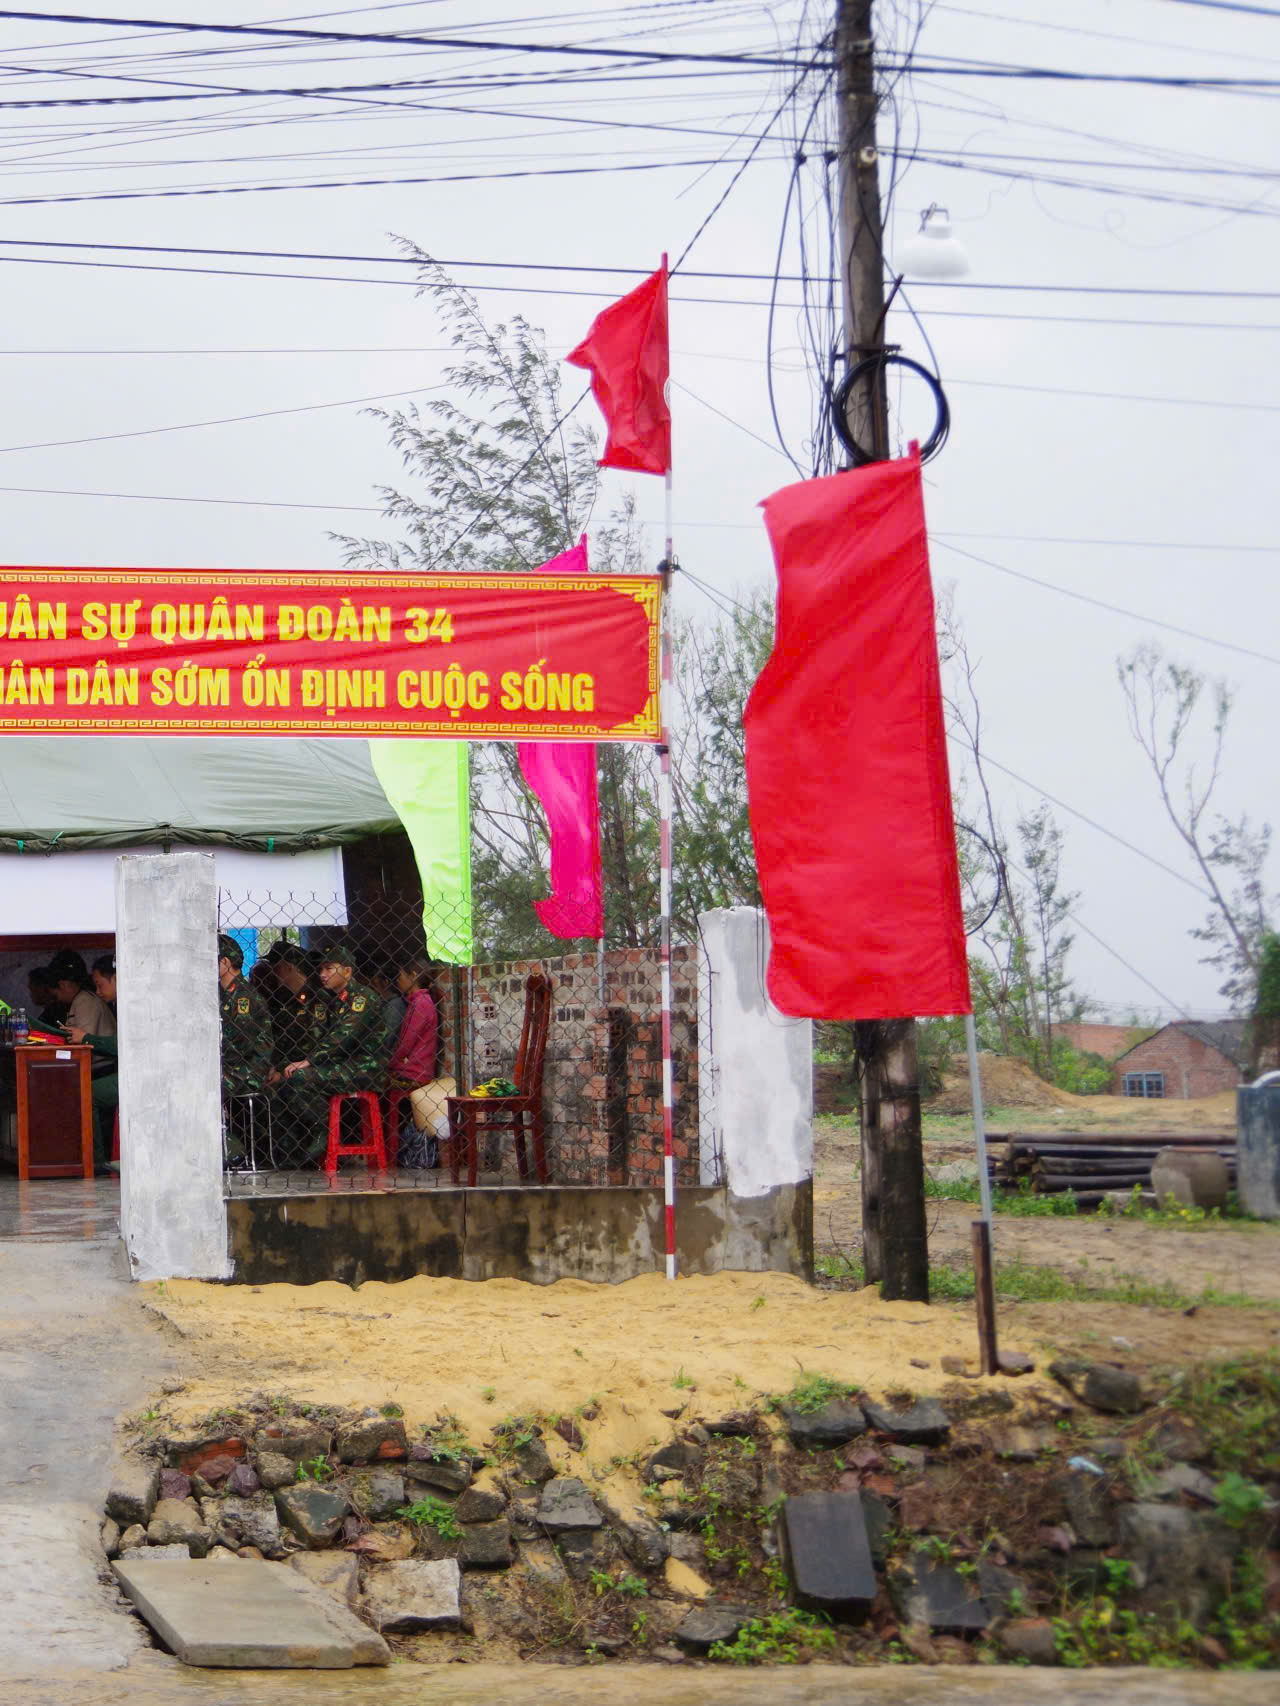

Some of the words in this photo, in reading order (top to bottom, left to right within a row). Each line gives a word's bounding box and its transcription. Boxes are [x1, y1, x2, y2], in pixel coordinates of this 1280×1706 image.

[82, 600, 141, 648] SỰ
[151, 597, 264, 644] QUÂN
[277, 598, 392, 642] ĐOÀN
[405, 608, 454, 642] 34
[67, 660, 138, 705] DÂN
[151, 661, 229, 706] SỚM
[242, 653, 290, 706] ỔN
[301, 670, 385, 715] ĐỊNH
[397, 663, 488, 717] CUỘC
[501, 659, 593, 711] SỐNG
